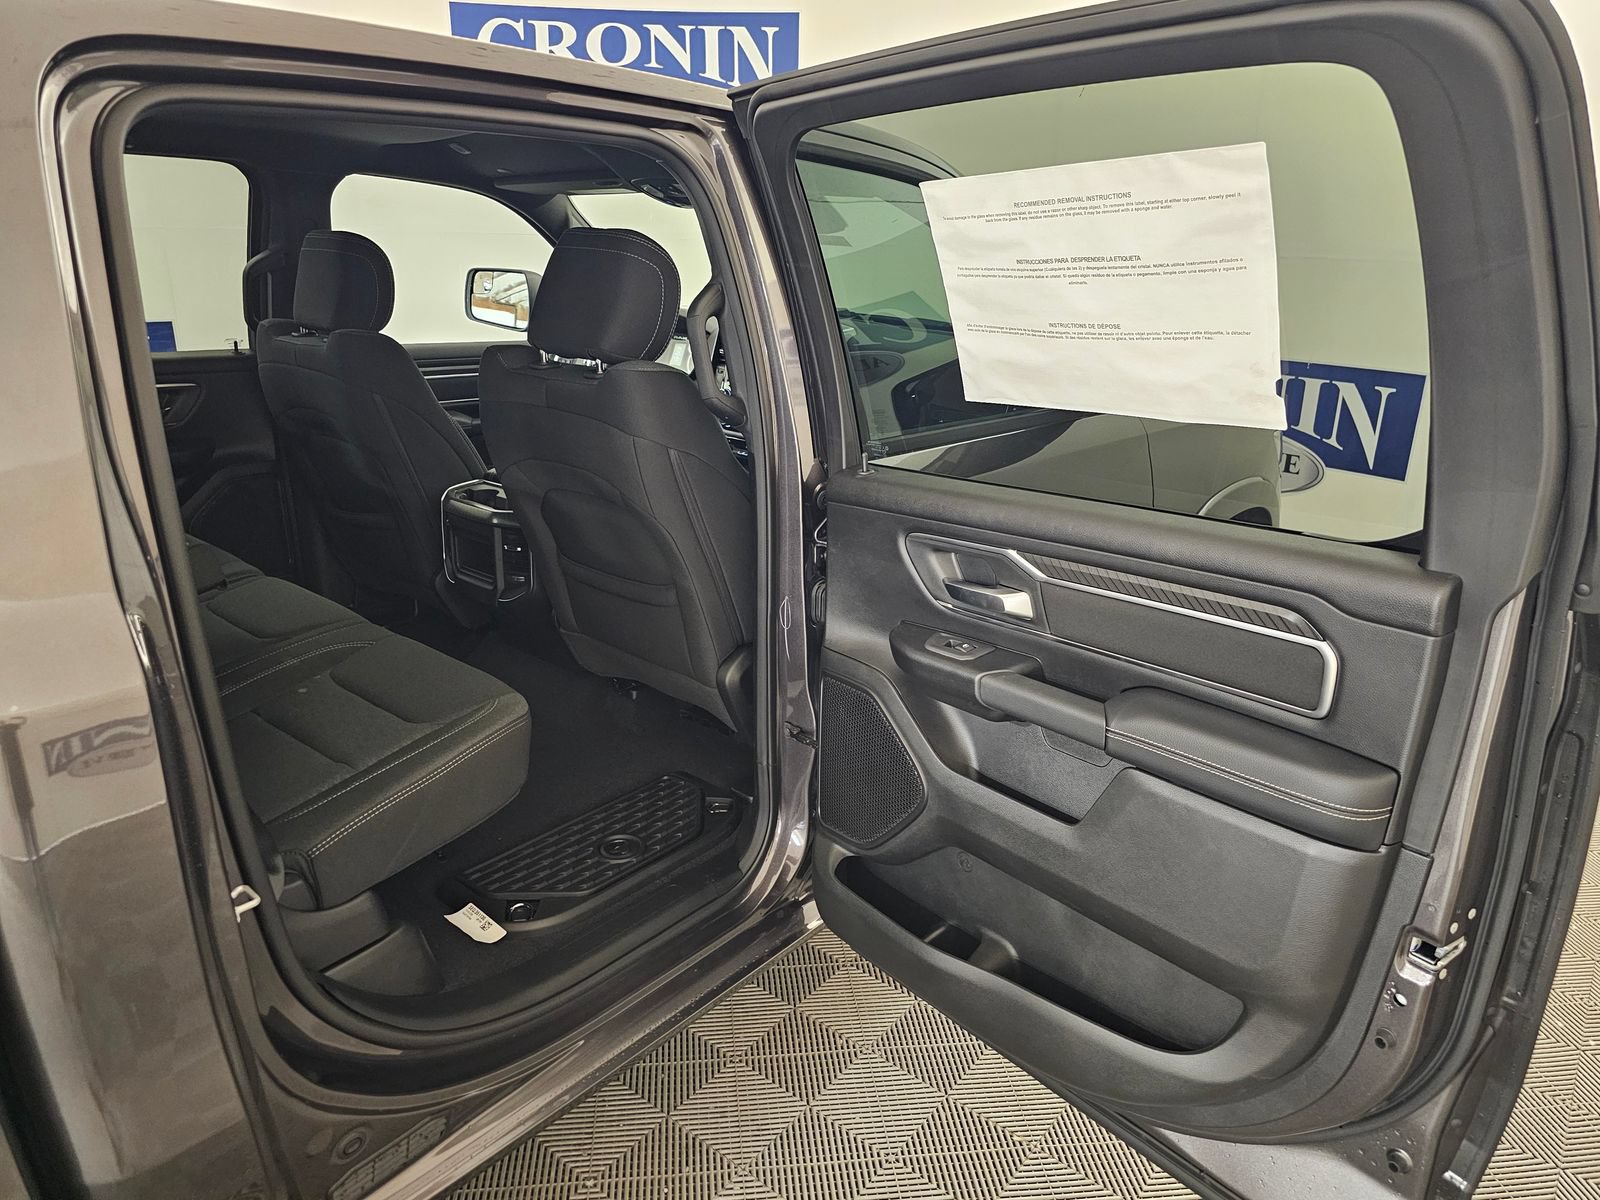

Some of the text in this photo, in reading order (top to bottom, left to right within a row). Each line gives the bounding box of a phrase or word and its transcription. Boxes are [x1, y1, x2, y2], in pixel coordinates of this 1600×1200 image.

[1013, 191, 1132, 209] RECOMMENDED REMOVAL INSTRUCTIONS
[1016, 258, 1054, 266] INSTRUCCIONES
[1070, 256, 1105, 264] DESPRENDER
[1097, 322, 1122, 330] DÉPOSE
